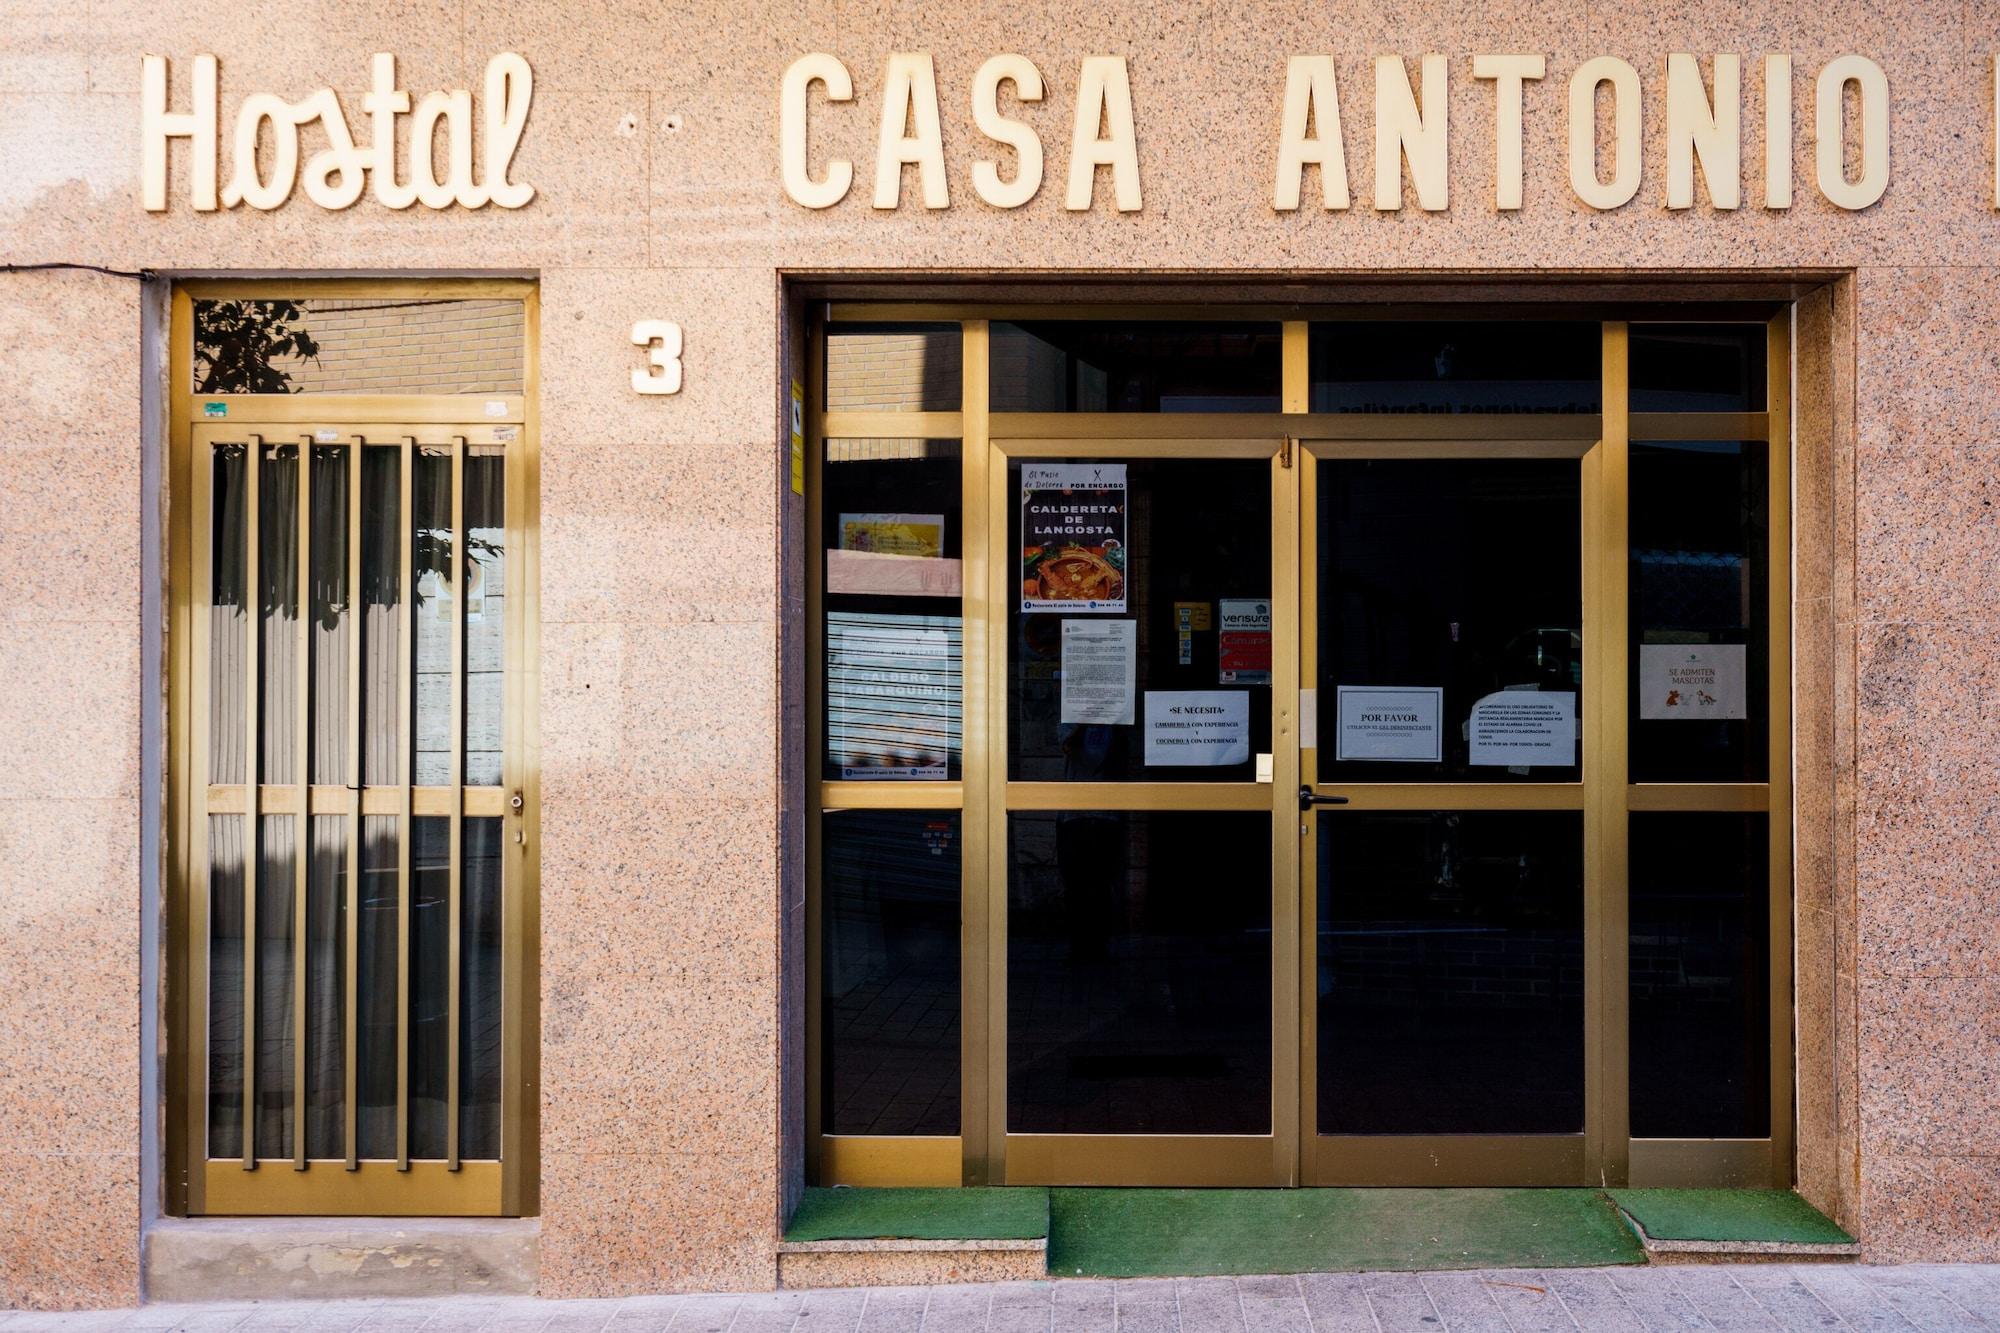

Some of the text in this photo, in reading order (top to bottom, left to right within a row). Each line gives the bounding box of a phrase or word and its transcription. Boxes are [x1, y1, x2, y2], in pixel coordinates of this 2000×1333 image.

[141, 51, 536, 213] Hostal
[781, 52, 1144, 212] CASA
[1273, 52, 1890, 212] ANTONIO
[630, 319, 684, 396] 3
[1030, 505, 1118, 514] CALDERETA
[1065, 515, 1084, 524] DE
[1034, 526, 1115, 535] LANGOSTA
[1223, 615, 1270, 623] verisure
[861, 672, 929, 682] CALDERO
[1668, 668, 1716, 677] SE ADMITEN
[1671, 677, 1716, 685] MASCOTAS
[848, 685, 945, 696] TABARQUINO
[1361, 713, 1419, 722] POR FAVOR
